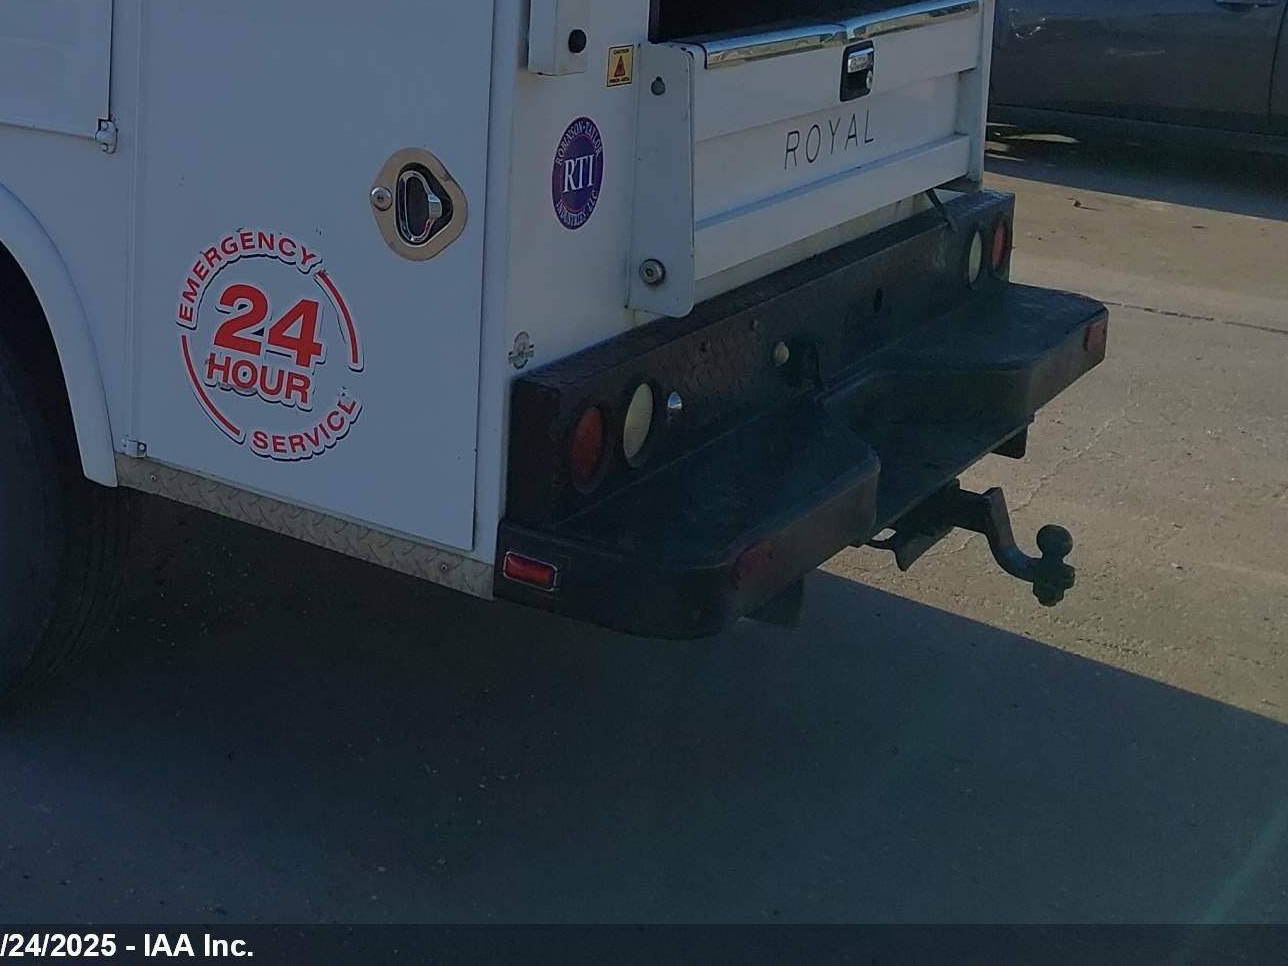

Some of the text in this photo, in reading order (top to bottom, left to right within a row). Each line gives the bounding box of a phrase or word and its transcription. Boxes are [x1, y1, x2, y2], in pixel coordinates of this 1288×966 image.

[785, 109, 874, 170] ROYAL
[563, 153, 595, 193] RTI
[179, 232, 316, 322] EMERGENCY
[214, 284, 323, 368] 24
[207, 353, 311, 404] HOUR
[253, 396, 357, 454] SERVICE
